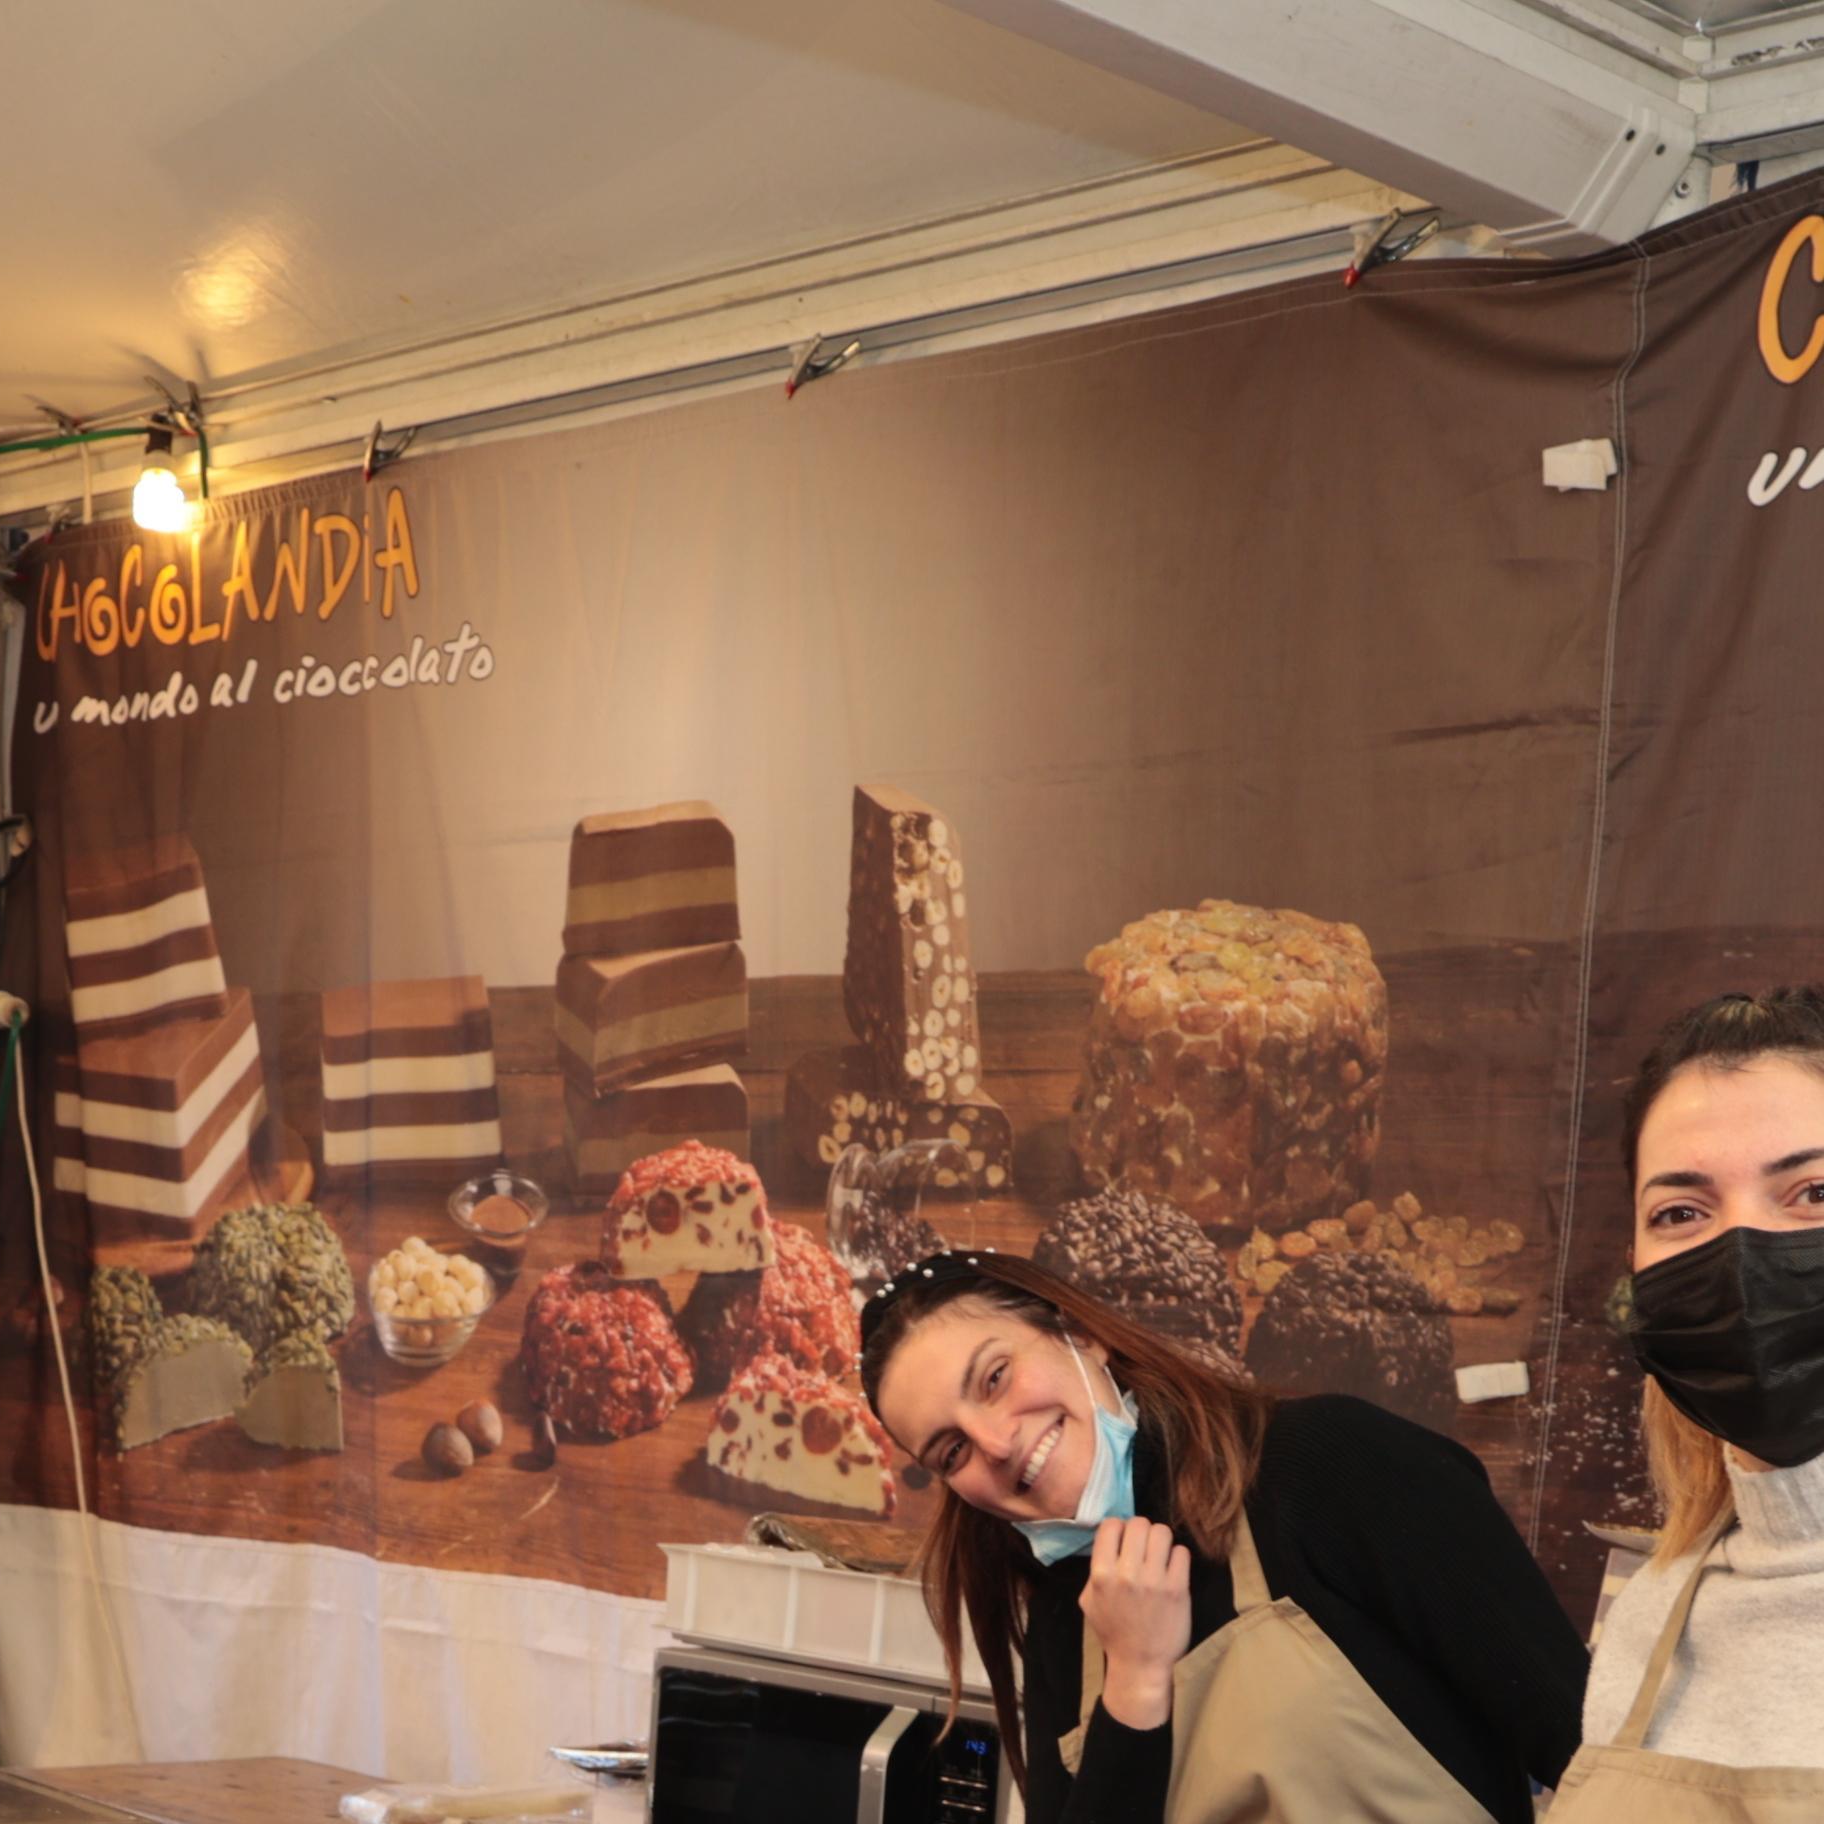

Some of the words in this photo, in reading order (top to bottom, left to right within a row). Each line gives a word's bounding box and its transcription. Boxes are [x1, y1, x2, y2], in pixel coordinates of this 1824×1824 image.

[71, 671, 198, 726] mondo
[210, 659, 257, 707] al
[274, 622, 494, 703] cioccolato
